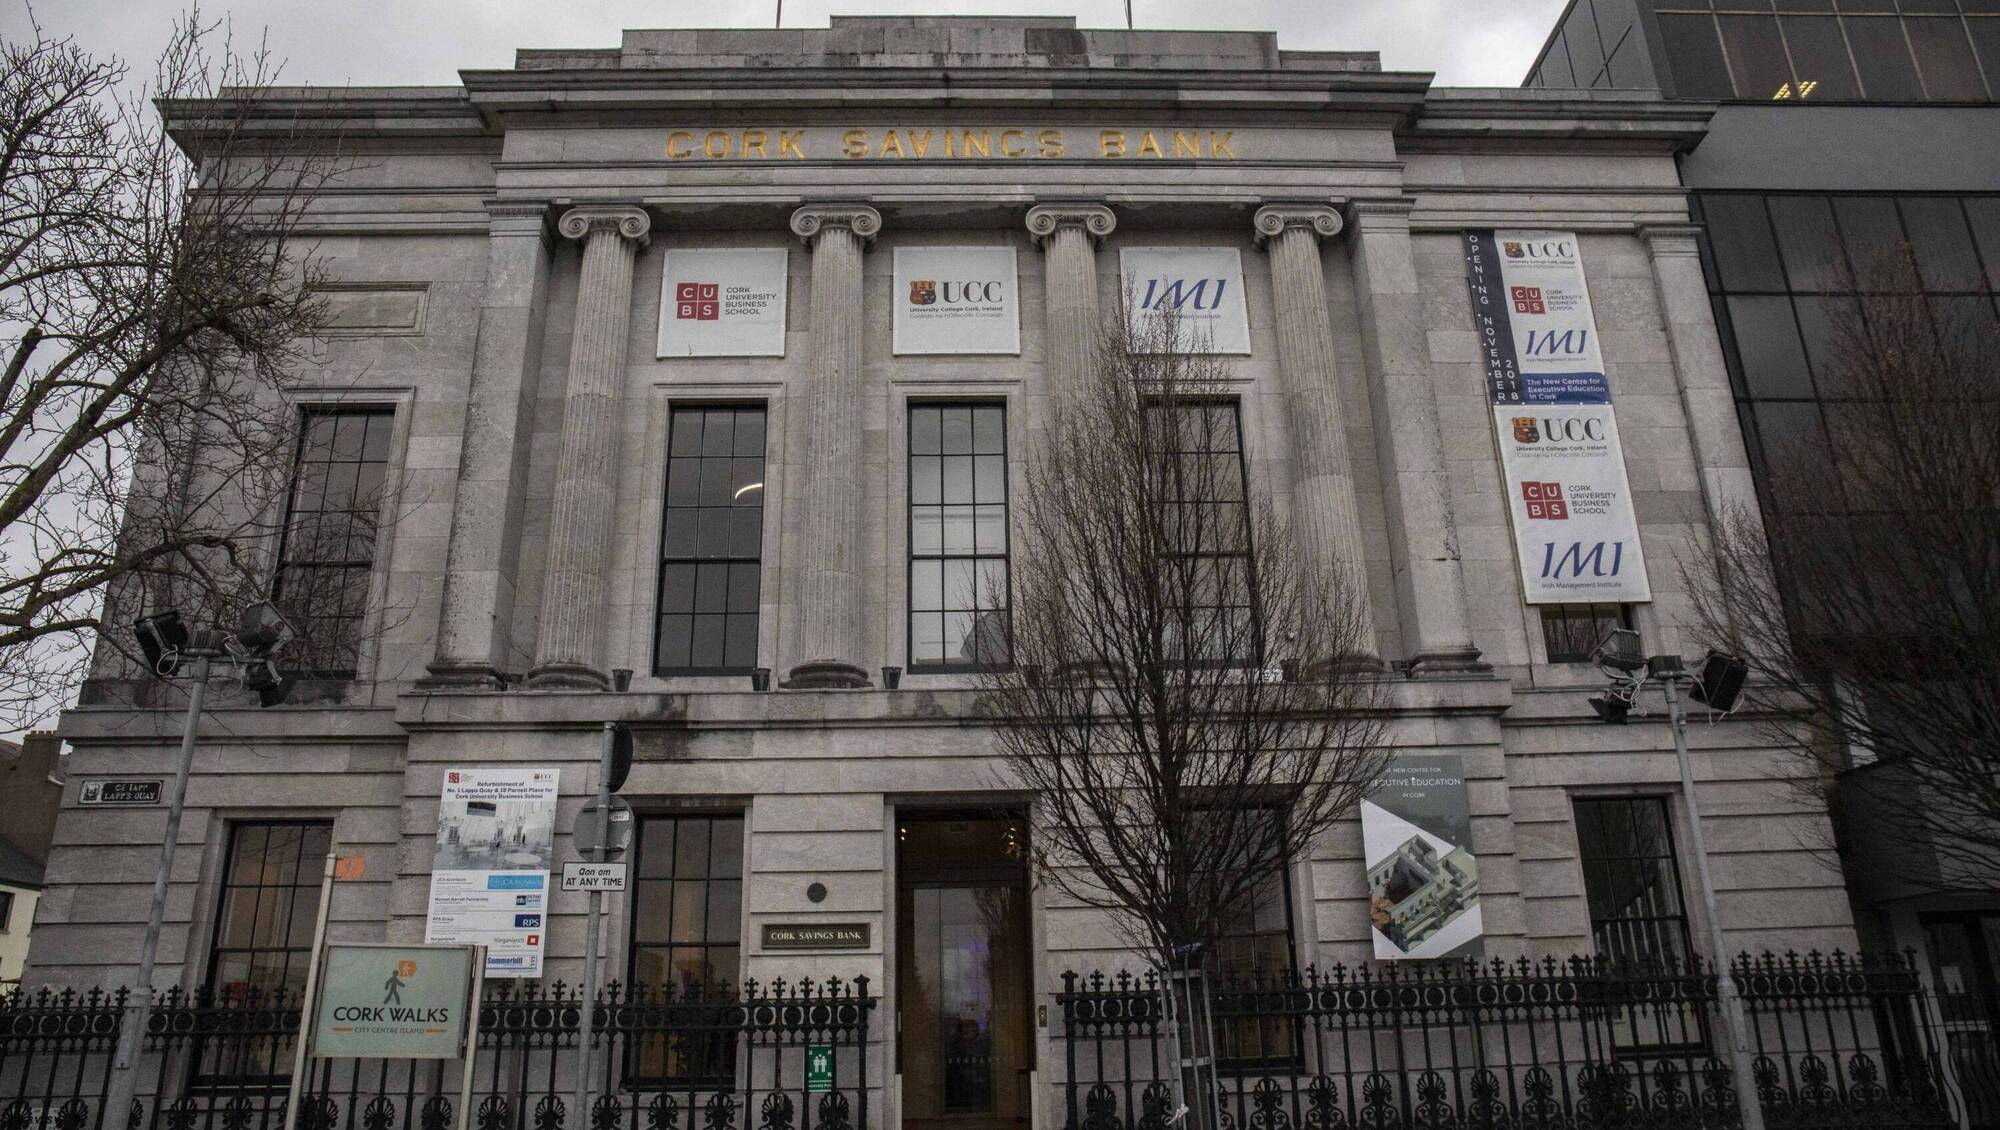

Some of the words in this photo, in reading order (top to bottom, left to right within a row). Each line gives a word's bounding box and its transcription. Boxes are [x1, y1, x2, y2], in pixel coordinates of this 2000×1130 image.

[666, 130, 806, 160] CORK
[1102, 129, 1236, 160] BANK
[1527, 242, 1574, 259] UCC
[725, 286, 751, 294] CORK
[943, 280, 1003, 304] UCC
[1141, 278, 1226, 311] IMI
[725, 293, 777, 301] UNIVERSITY
[724, 308, 761, 316] SCHOOL
[1525, 329, 1587, 355] IMI
[1541, 417, 1606, 442] UCC
[1571, 499, 1611, 507] BUSINESS
[1541, 541, 1623, 579] IMI
[1411, 778, 1461, 786] EDUCATION
[134, 792, 155, 800] QUAY
[565, 877, 576, 886] AT
[579, 877, 599, 886] ANY
[602, 877, 623, 886] TIME
[522, 918, 540, 928] RPS
[770, 932, 796, 940] CORK
[799, 931, 834, 940] SAVINGS
[837, 931, 862, 939] BANK
[333, 1006, 386, 1022] CORK
[389, 1007, 449, 1023] WALKS
